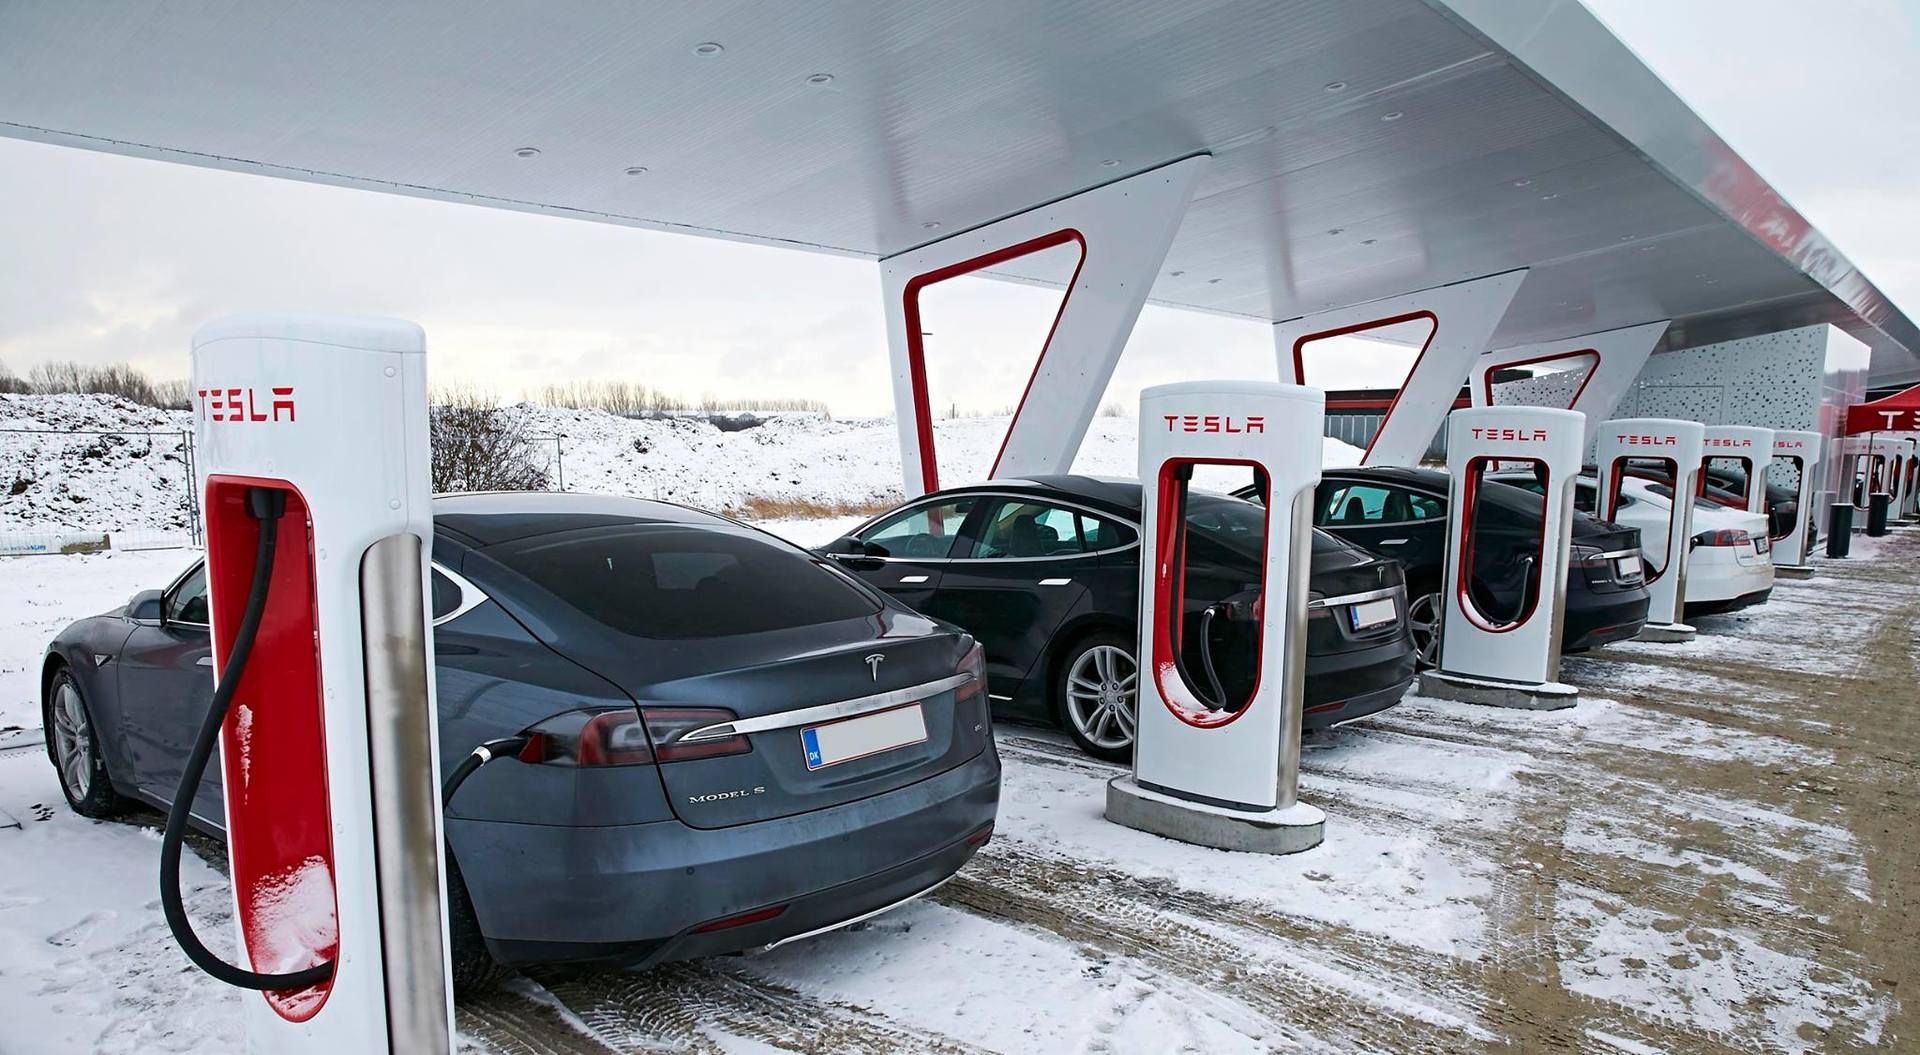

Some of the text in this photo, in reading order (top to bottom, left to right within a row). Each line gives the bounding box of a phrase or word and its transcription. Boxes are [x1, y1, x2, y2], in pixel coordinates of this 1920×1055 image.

[198, 387, 295, 422] TESLA
[1164, 415, 1264, 434] TESLA
[1471, 428, 1547, 442] TESLA
[1617, 435, 1676, 446] TESLA
[809, 752, 819, 760] DK
[689, 786, 765, 804] MODEL S
